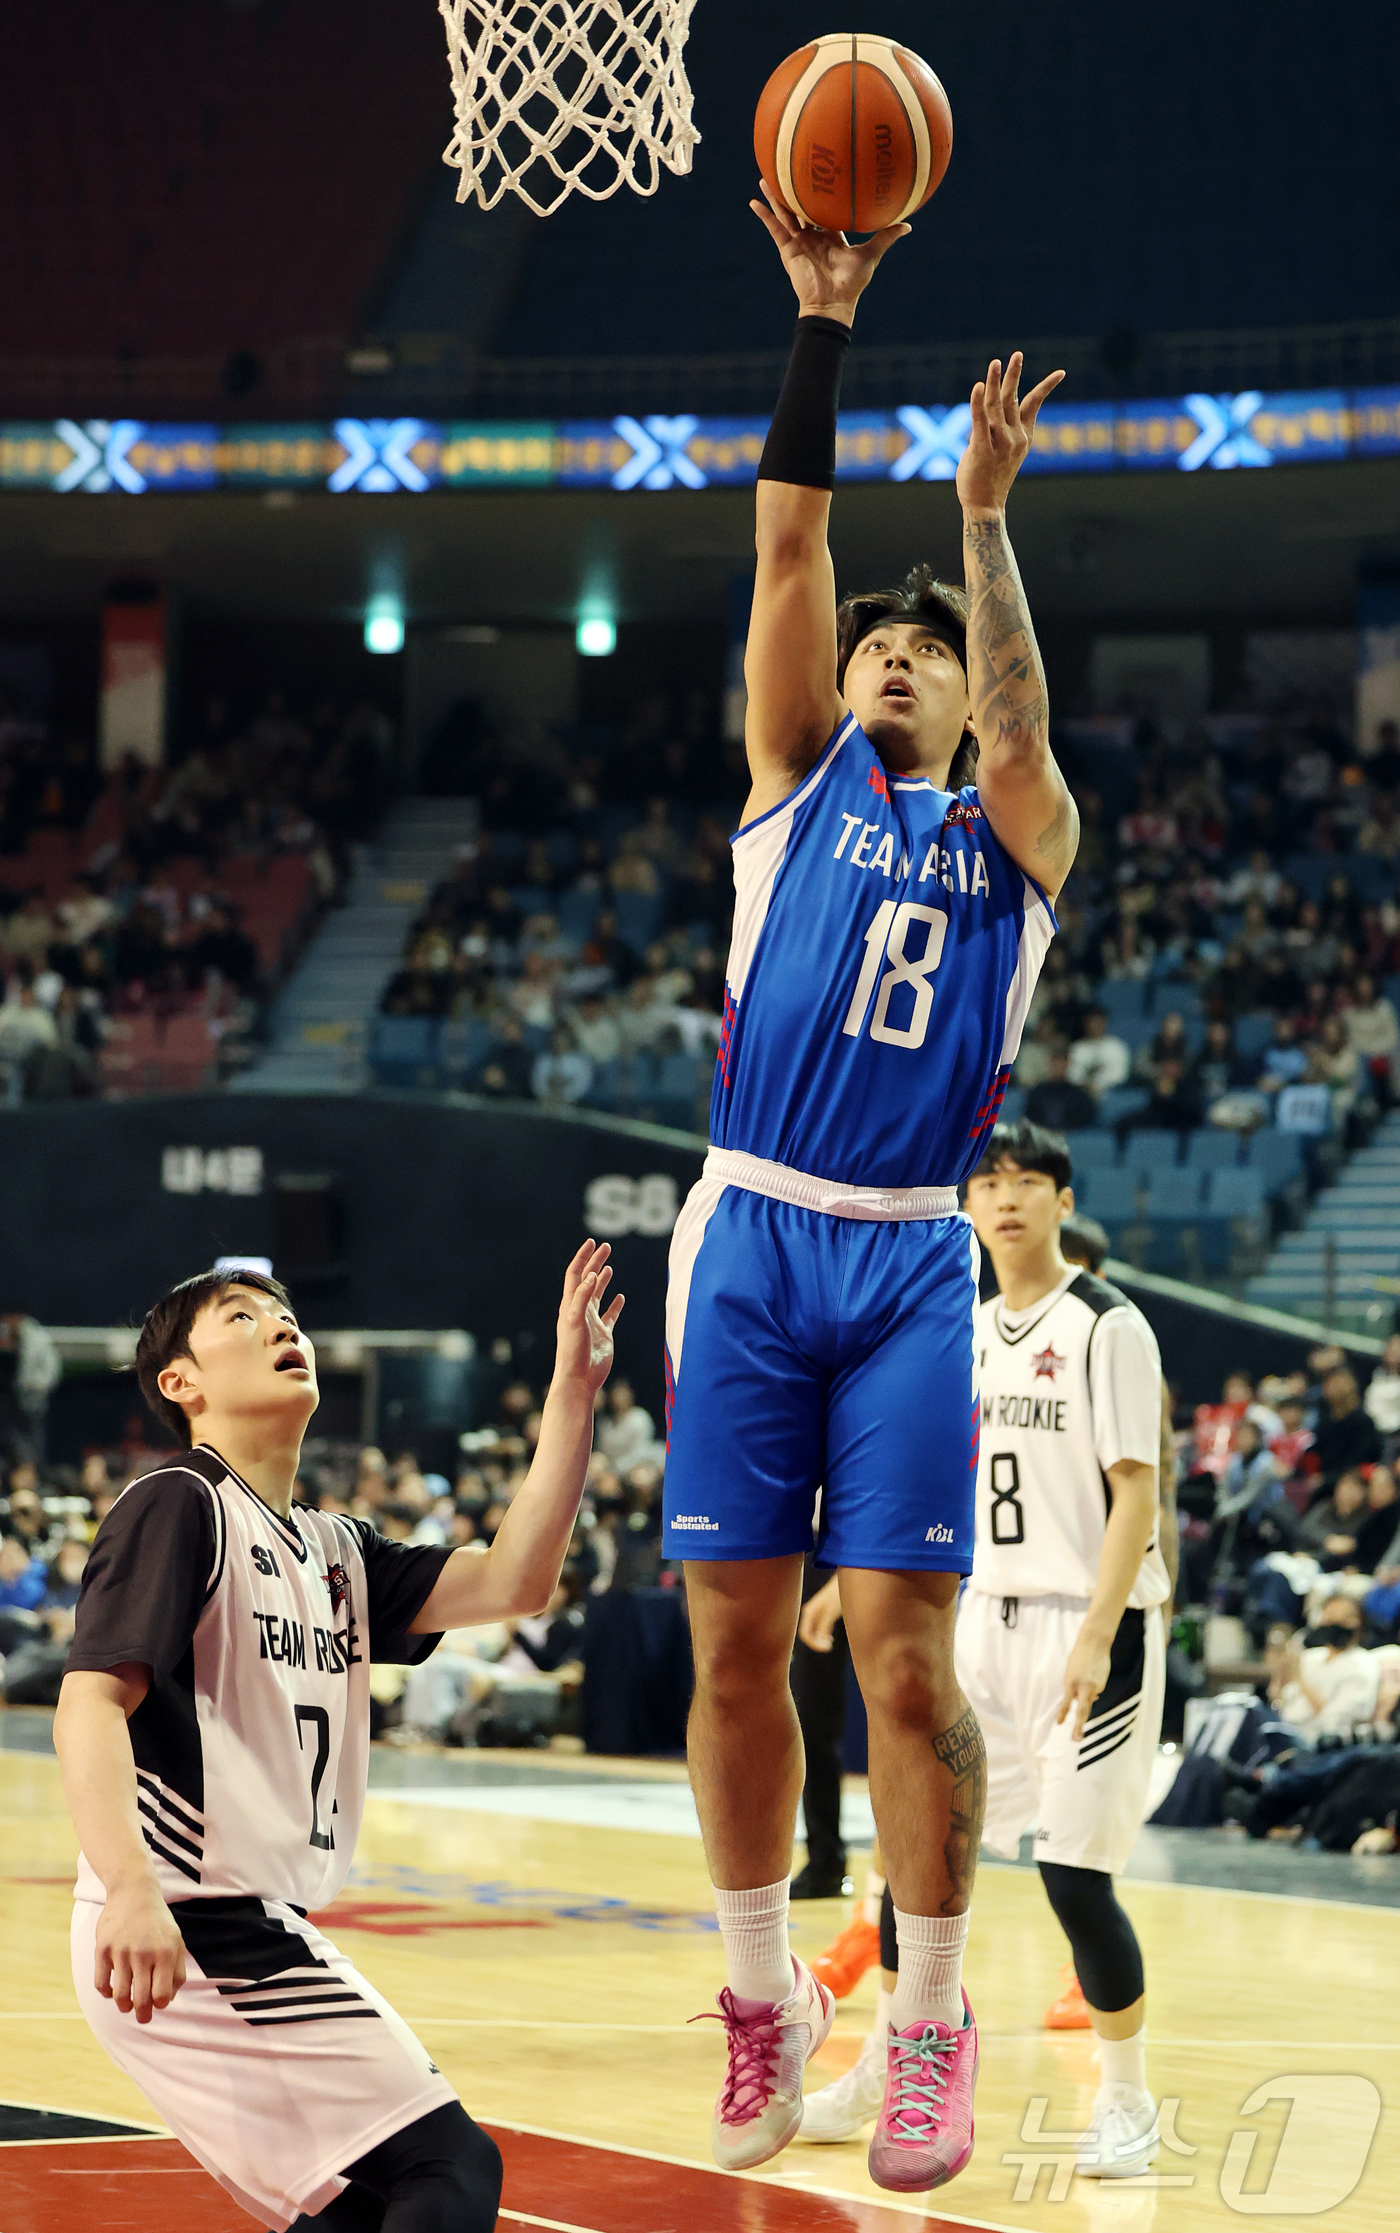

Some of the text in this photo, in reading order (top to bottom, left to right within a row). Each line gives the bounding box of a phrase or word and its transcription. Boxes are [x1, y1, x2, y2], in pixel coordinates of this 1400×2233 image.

[810, 143, 841, 196] KBL
[875, 124, 896, 207] molten
[833, 812, 990, 899] TEAM ASIA
[842, 899, 948, 1050] 18
[999, 1396, 1067, 1432] ROOKIE
[676, 1513, 710, 1524] Sports
[991, 1452, 1024, 1545] 8
[670, 1519, 719, 1531] Illustrated
[924, 1522, 954, 1543] KBL
[250, 1543, 282, 1579] SI
[252, 1611, 307, 1671] TEAM
[949, 1739, 980, 1774] YOUR
